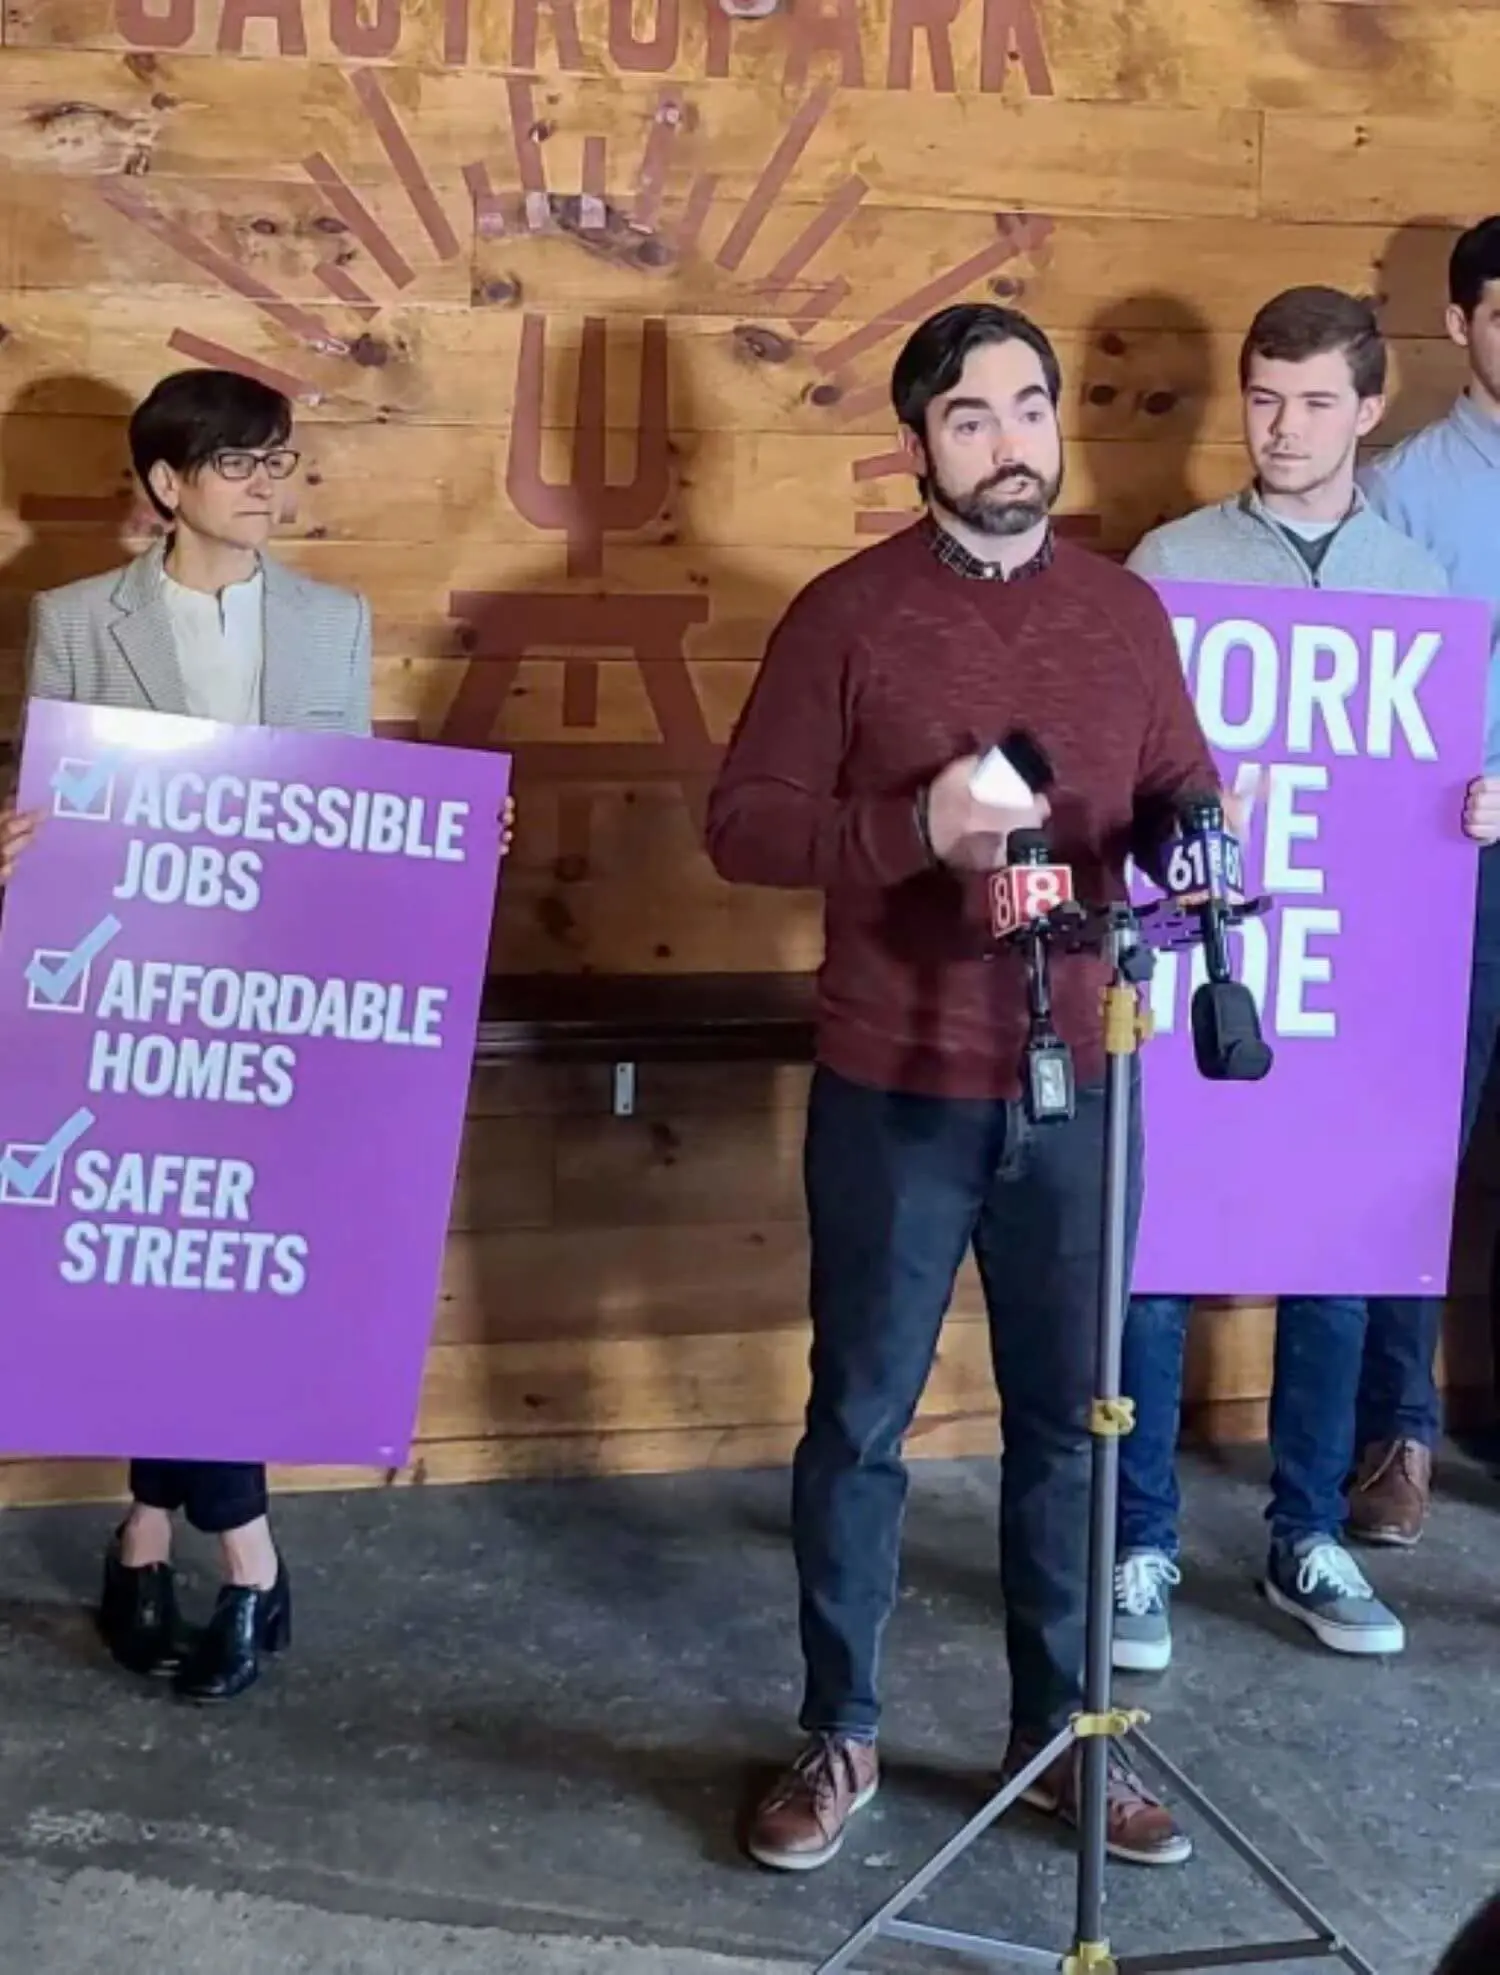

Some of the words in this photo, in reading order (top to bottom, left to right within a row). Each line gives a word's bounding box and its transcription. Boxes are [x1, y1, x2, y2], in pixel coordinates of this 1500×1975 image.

[122, 768, 470, 861] ACCESSIBLE
[113, 839, 263, 912] JOBS
[1026, 870, 1061, 919] 8
[1167, 840, 1205, 891] 61
[96, 959, 448, 1047] AFFORDABLE
[88, 1029, 296, 1107] HOMES
[70, 1149, 255, 1221] SAFER
[59, 1221, 308, 1295] STREETS
